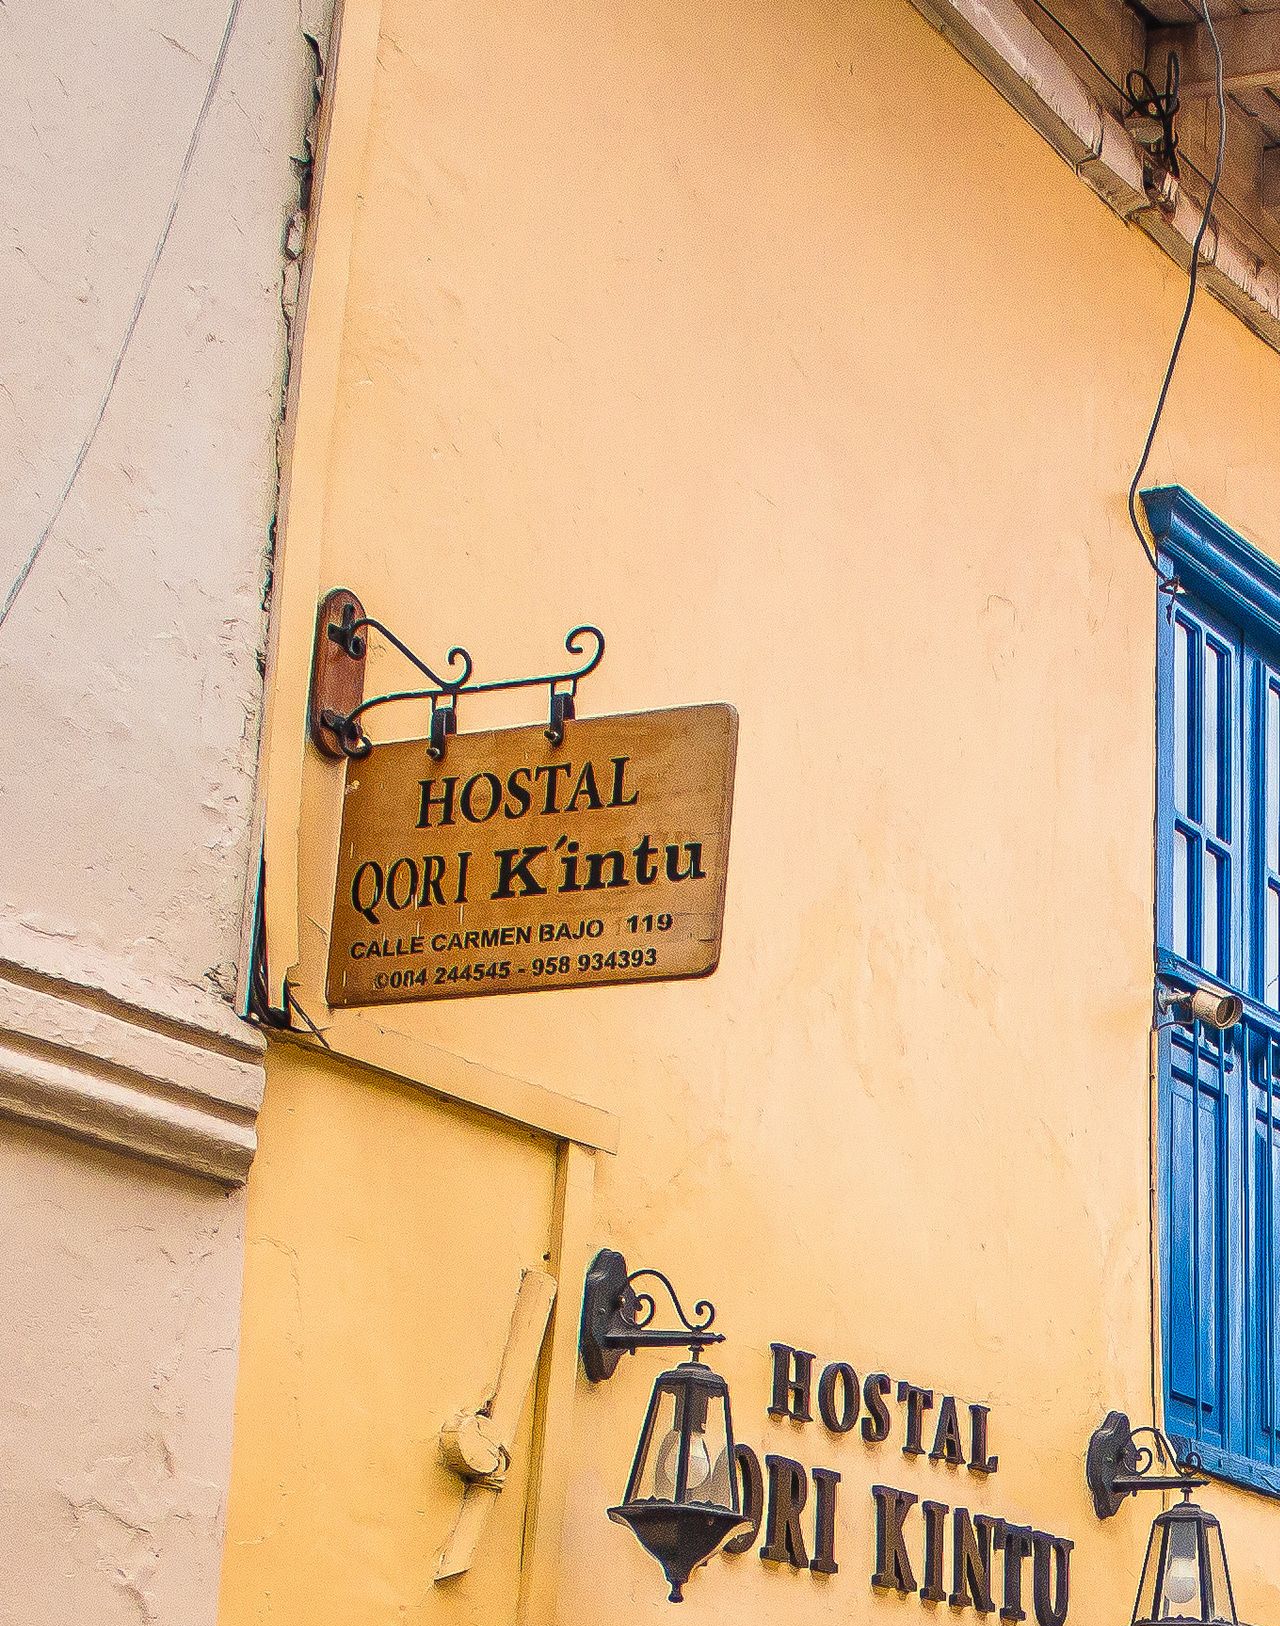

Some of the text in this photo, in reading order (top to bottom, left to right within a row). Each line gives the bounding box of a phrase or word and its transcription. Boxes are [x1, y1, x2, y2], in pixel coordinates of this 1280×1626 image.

[414, 755, 641, 829] HOSTAL
[350, 851, 474, 925] QORI
[350, 912, 675, 961] CALLE CARMEN BAJO 119
[432, 959, 512, 986] 244545
[531, 954, 571, 978] 958
[576, 946, 659, 974] 934393
[766, 1342, 999, 1474] HOSTAL
[720, 1443, 841, 1575] ORI
